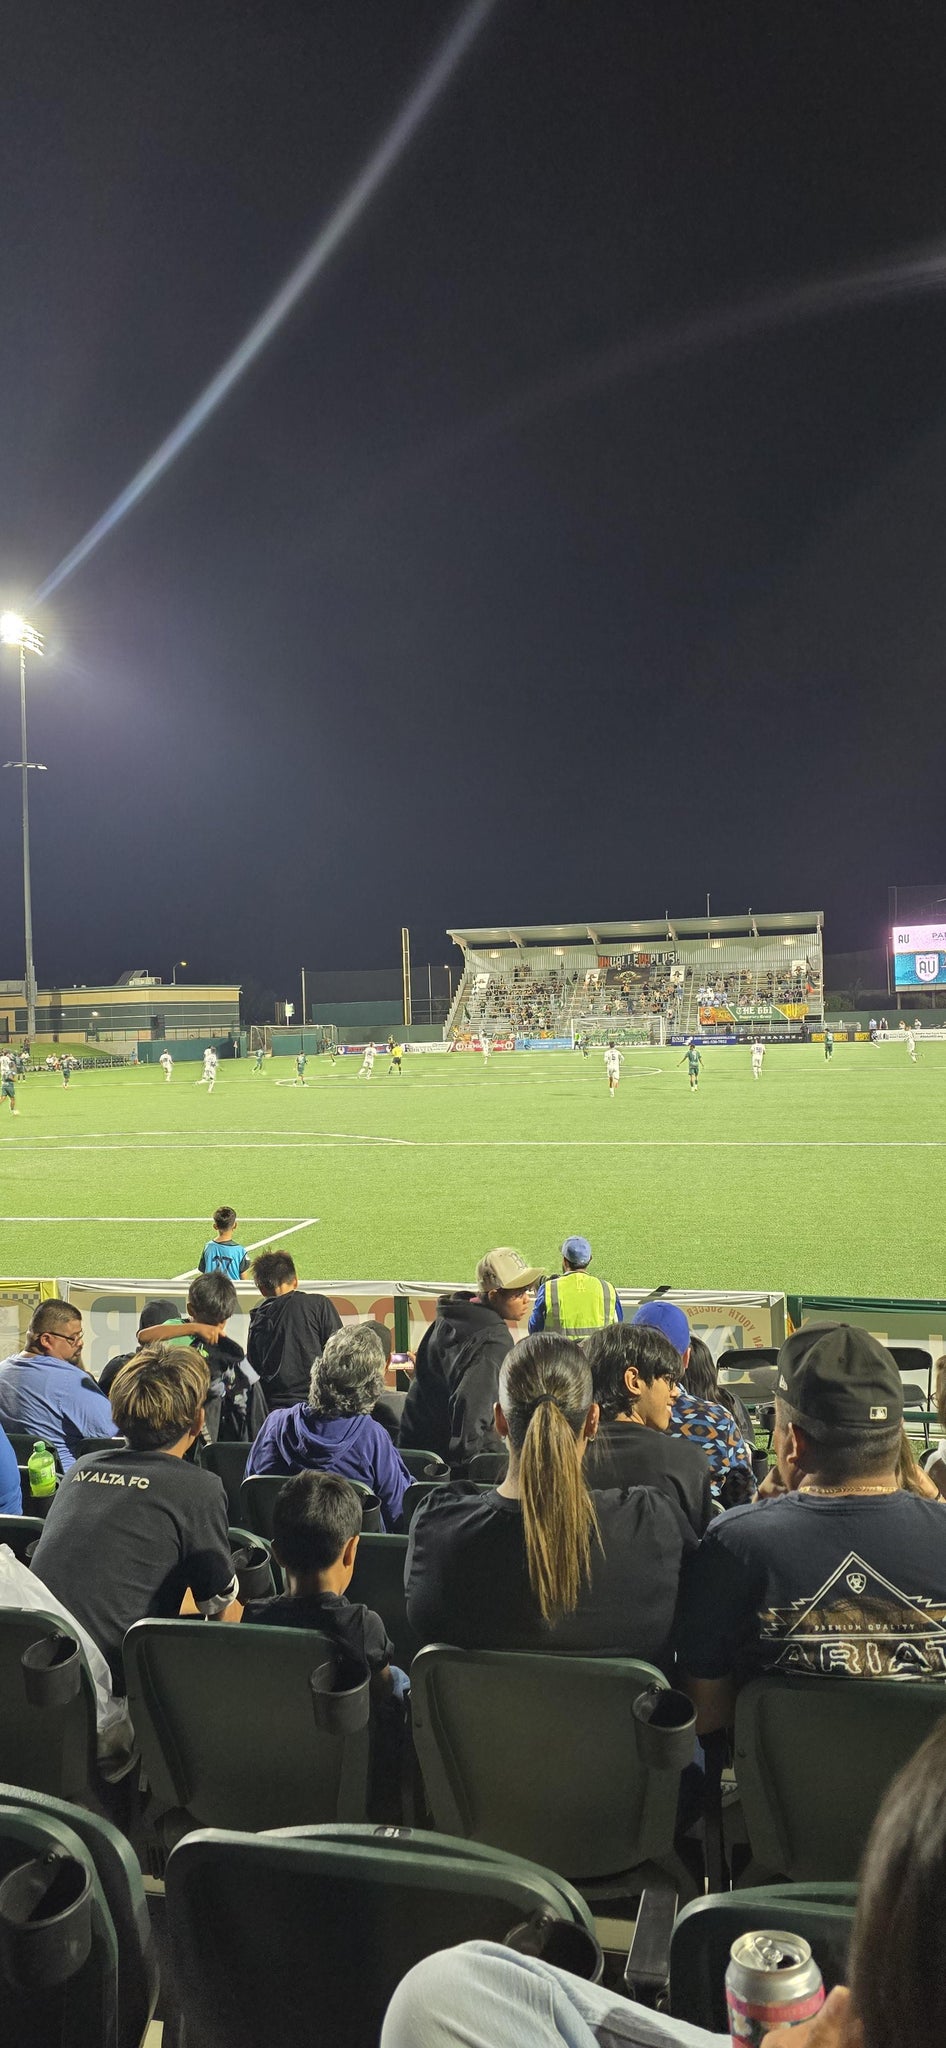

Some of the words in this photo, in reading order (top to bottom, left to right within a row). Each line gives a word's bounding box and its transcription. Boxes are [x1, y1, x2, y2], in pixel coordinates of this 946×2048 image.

[898, 934, 910, 944] AU
[919, 960, 936, 974] AU
[735, 1007, 756, 1015] THE
[757, 1006, 773, 1014] 661
[71, 1470, 92, 1483] AV
[88, 1471, 126, 1486] ALTA
[128, 1475, 150, 1490] FC
[814, 1623, 861, 1632] PREMIUM
[867, 1623, 916, 1632] QUALITY
